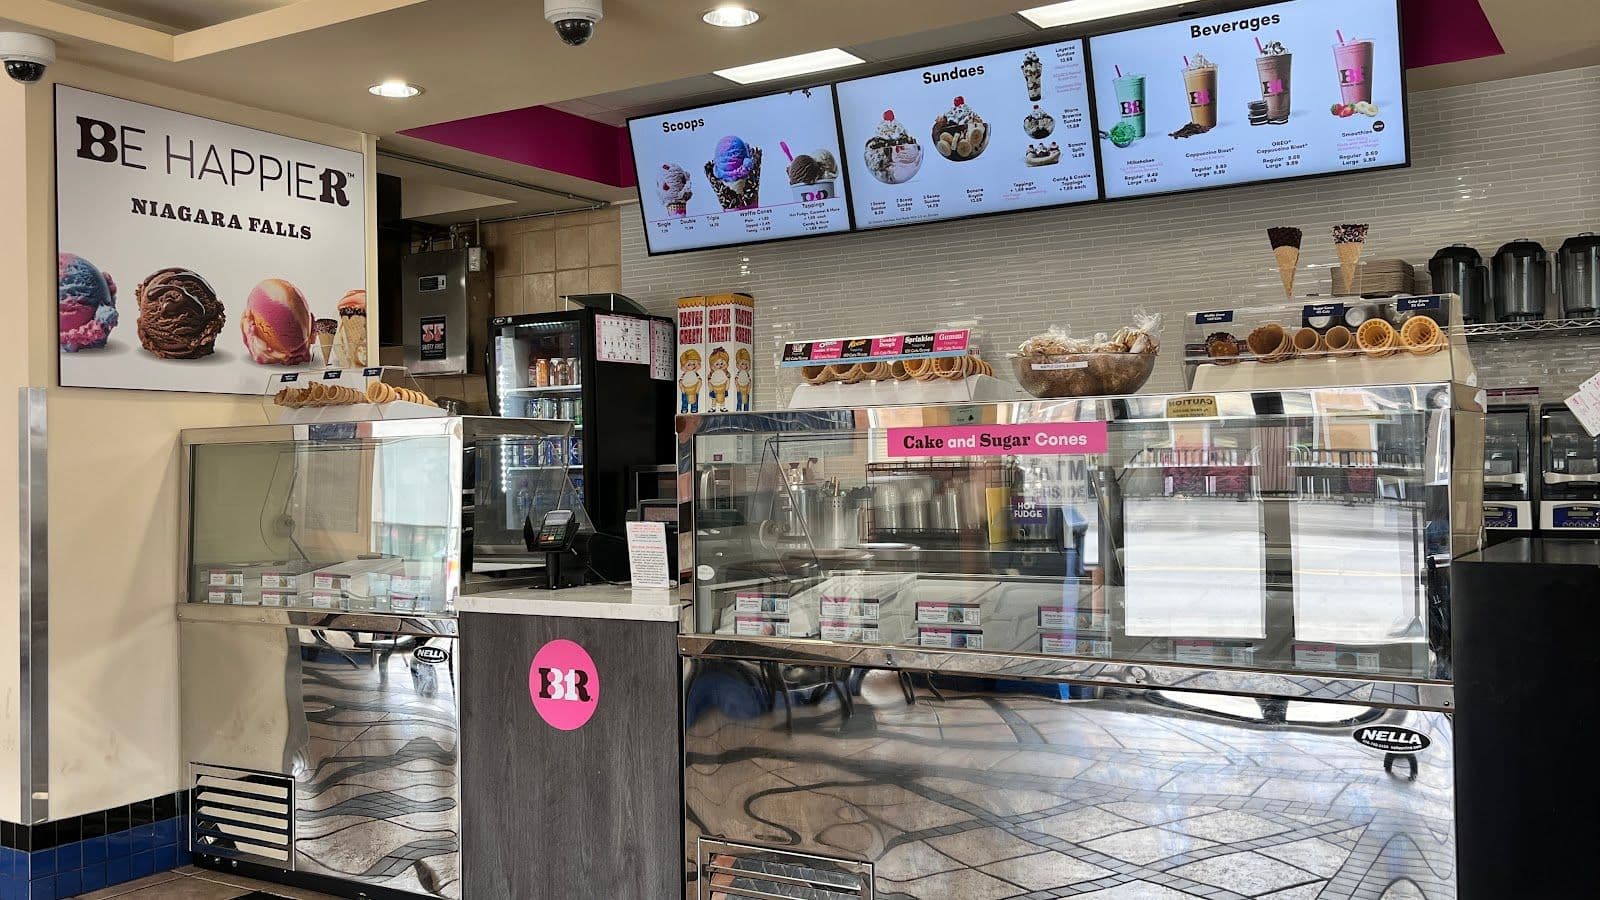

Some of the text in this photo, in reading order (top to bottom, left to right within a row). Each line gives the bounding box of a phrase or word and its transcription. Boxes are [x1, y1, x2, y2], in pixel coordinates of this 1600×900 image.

[1190, 13, 1280, 38] Beverages
[922, 64, 984, 84] Sundaes
[662, 118, 704, 132] Scoops
[76, 116, 146, 170] BE
[131, 198, 312, 240] NIAGARA FALLS
[680, 311, 703, 327] TASTES
[709, 309, 730, 325] SUPER
[680, 328, 702, 344] GREAT!
[708, 326, 731, 343] TREAT!
[905, 335, 934, 344] Sprinkles
[903, 432, 1088, 451] Cake and Sugar Cones
[416, 649, 444, 660] NELLA
[1361, 729, 1422, 744] NELLA
